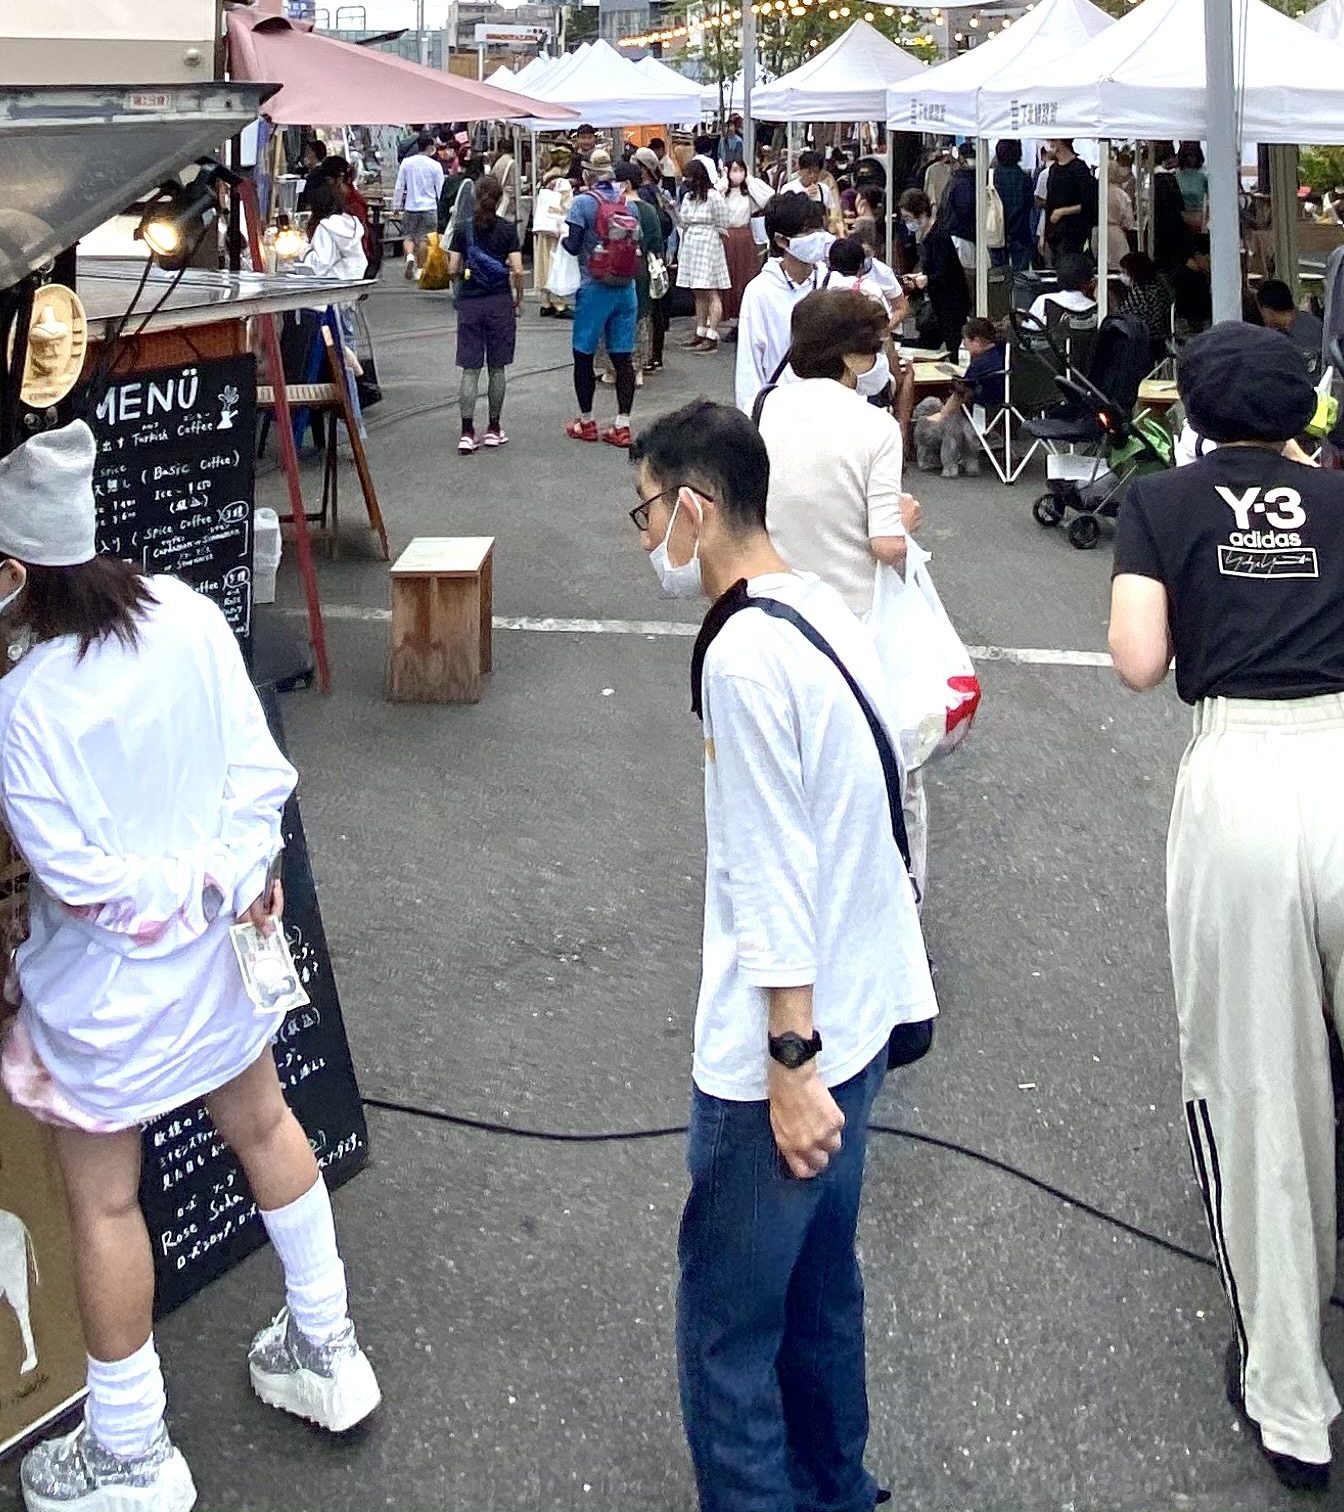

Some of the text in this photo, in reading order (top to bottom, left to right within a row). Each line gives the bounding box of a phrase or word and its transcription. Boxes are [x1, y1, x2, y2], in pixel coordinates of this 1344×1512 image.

[177, 419, 213, 437] Coffee
[1214, 485, 1307, 530] Y-3
[1229, 530, 1302, 548] adidas
[161, 1192, 245, 1257] Rose Soda
